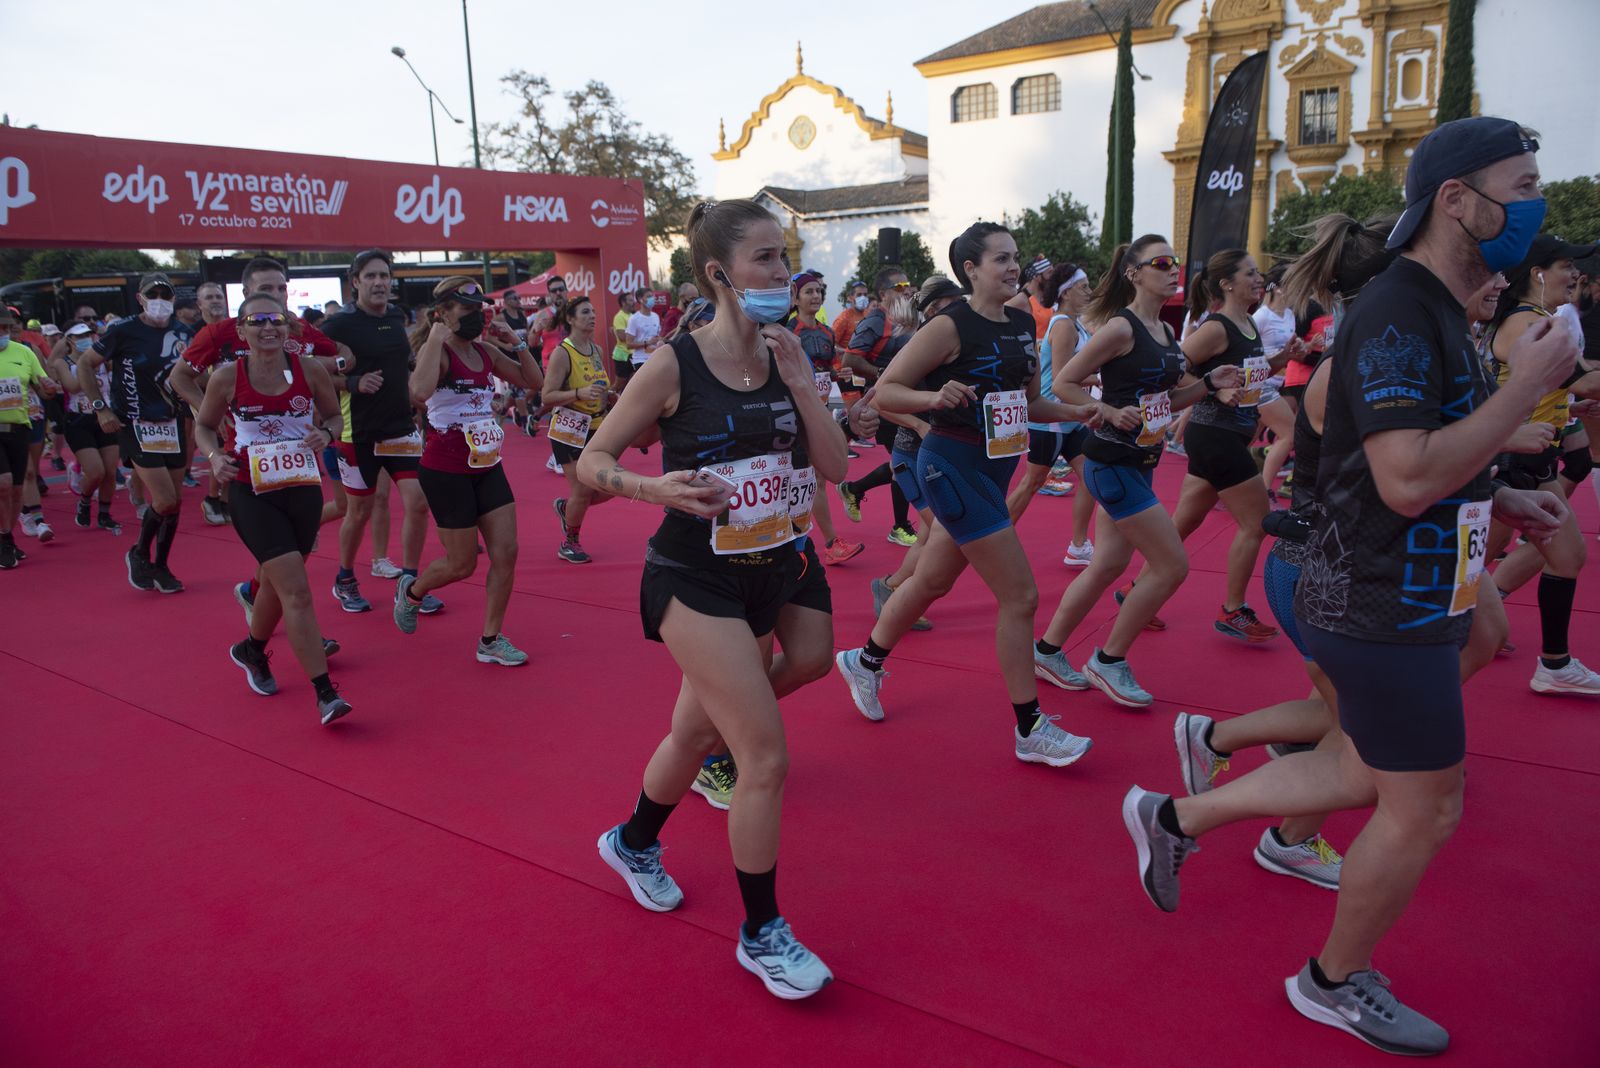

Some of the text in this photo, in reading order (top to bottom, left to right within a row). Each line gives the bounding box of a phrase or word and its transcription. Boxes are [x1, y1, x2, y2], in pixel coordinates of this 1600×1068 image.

[102, 165, 169, 213] edp
[218, 172, 327, 196] maratón
[1207, 164, 1244, 197] edp
[250, 191, 330, 215] sevilla
[394, 174, 465, 238] edp
[504, 194, 568, 223] HOKA
[179, 213, 292, 228] 17 octubre 2021
[565, 264, 596, 297] edp
[608, 262, 646, 302] edp
[1364, 385, 1425, 403] VERTICAL
[742, 402, 768, 410] VERTICAL
[992, 405, 1024, 427] 5378
[1144, 402, 1170, 422] 6445
[140, 425, 170, 437] 4845
[556, 414, 583, 432] 6552
[258, 452, 305, 473] 6189
[716, 464, 735, 477] edp
[750, 458, 767, 471] edp
